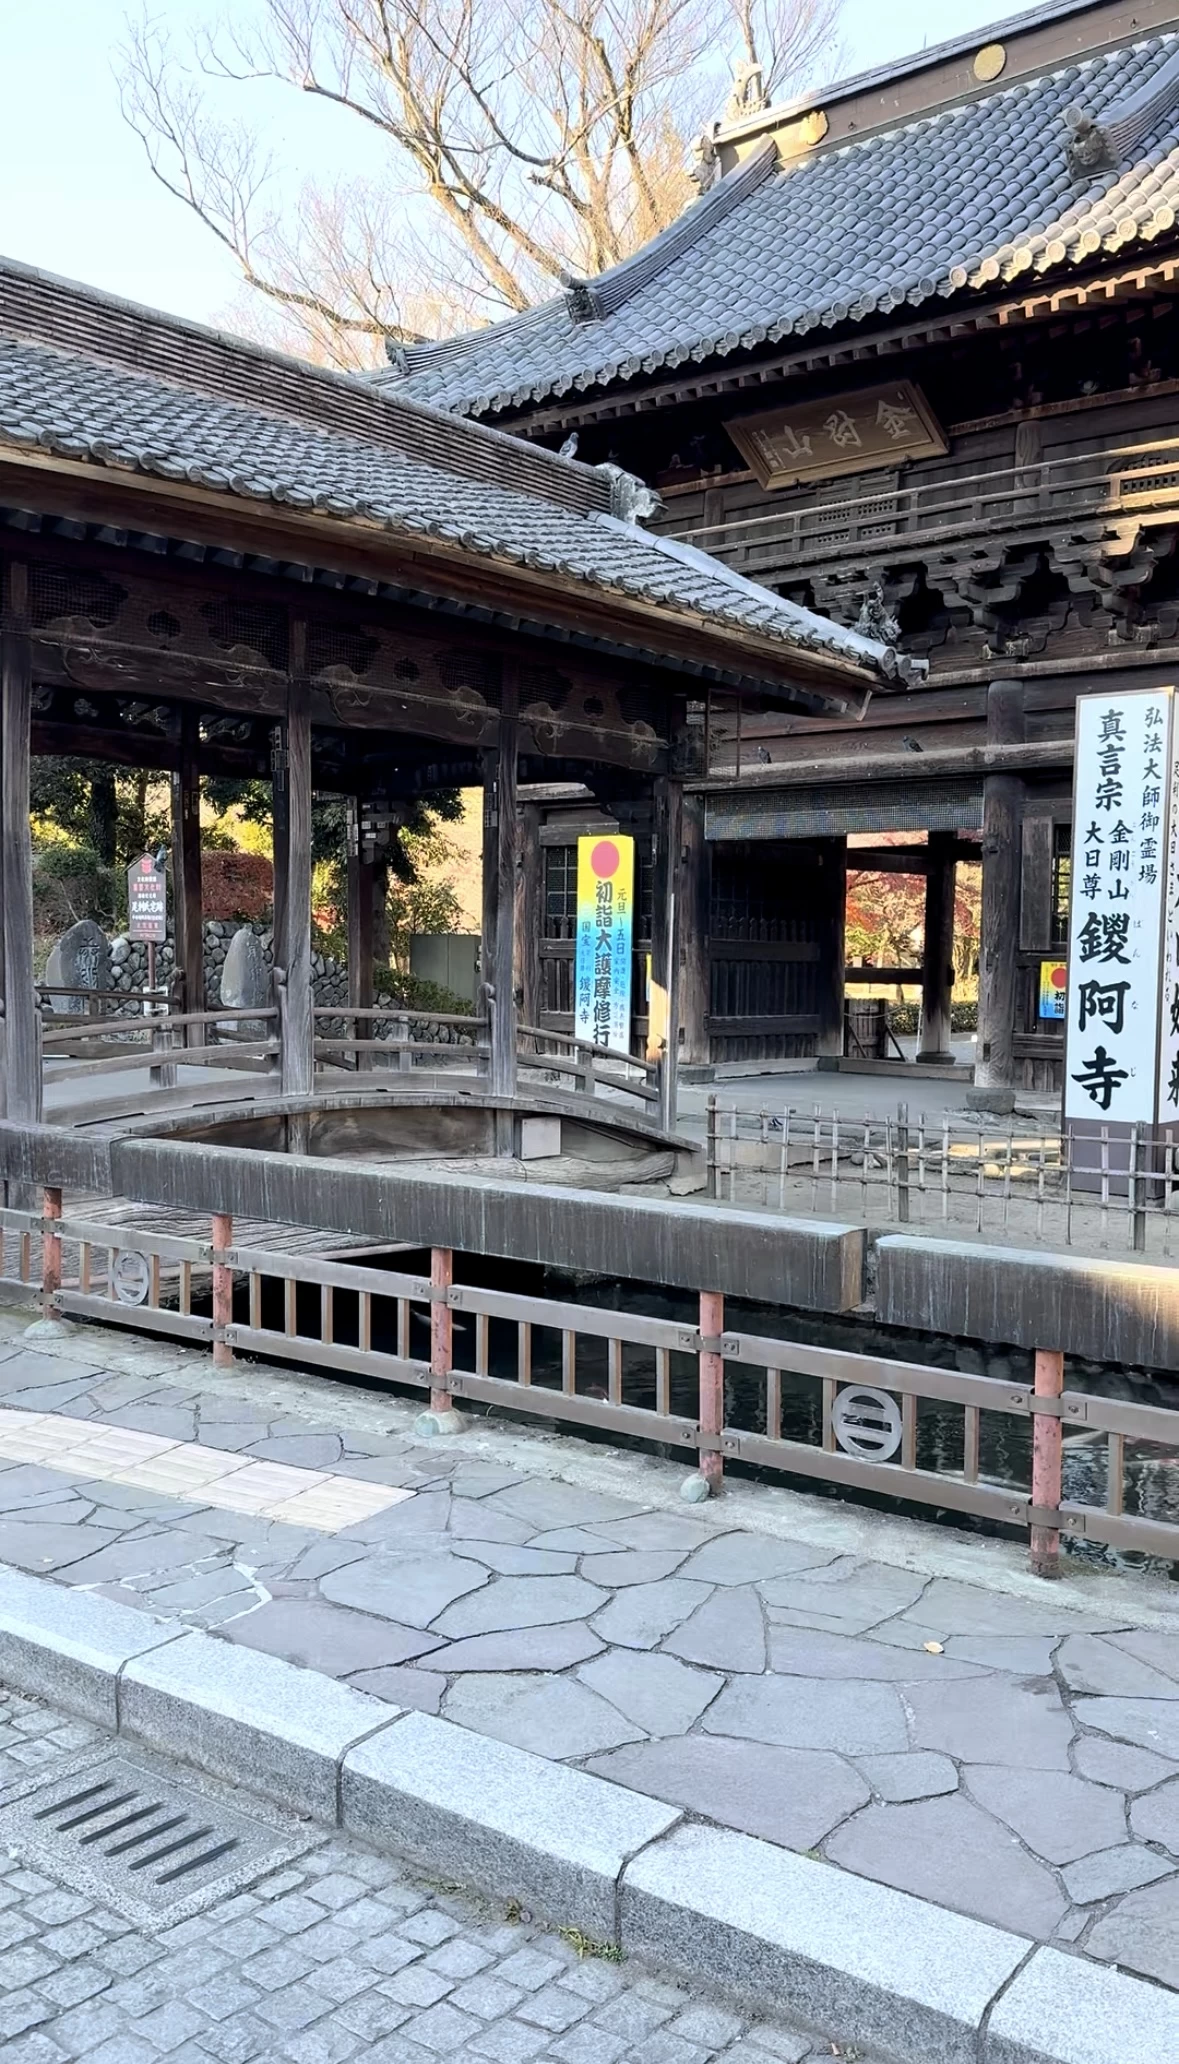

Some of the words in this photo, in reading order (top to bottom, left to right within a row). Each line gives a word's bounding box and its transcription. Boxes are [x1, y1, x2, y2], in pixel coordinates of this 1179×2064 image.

[1095, 708, 1127, 812] 真言宗
[1138, 706, 1164, 886] 弘法大師御霊場
[1079, 820, 1105, 901] 大日尊
[1107, 819, 1134, 901] 金剛山
[580, 921, 592, 947] 国宝
[592, 880, 613, 1048] 初詣大護摩修行
[1054, 991, 1066, 1015] 初詣
